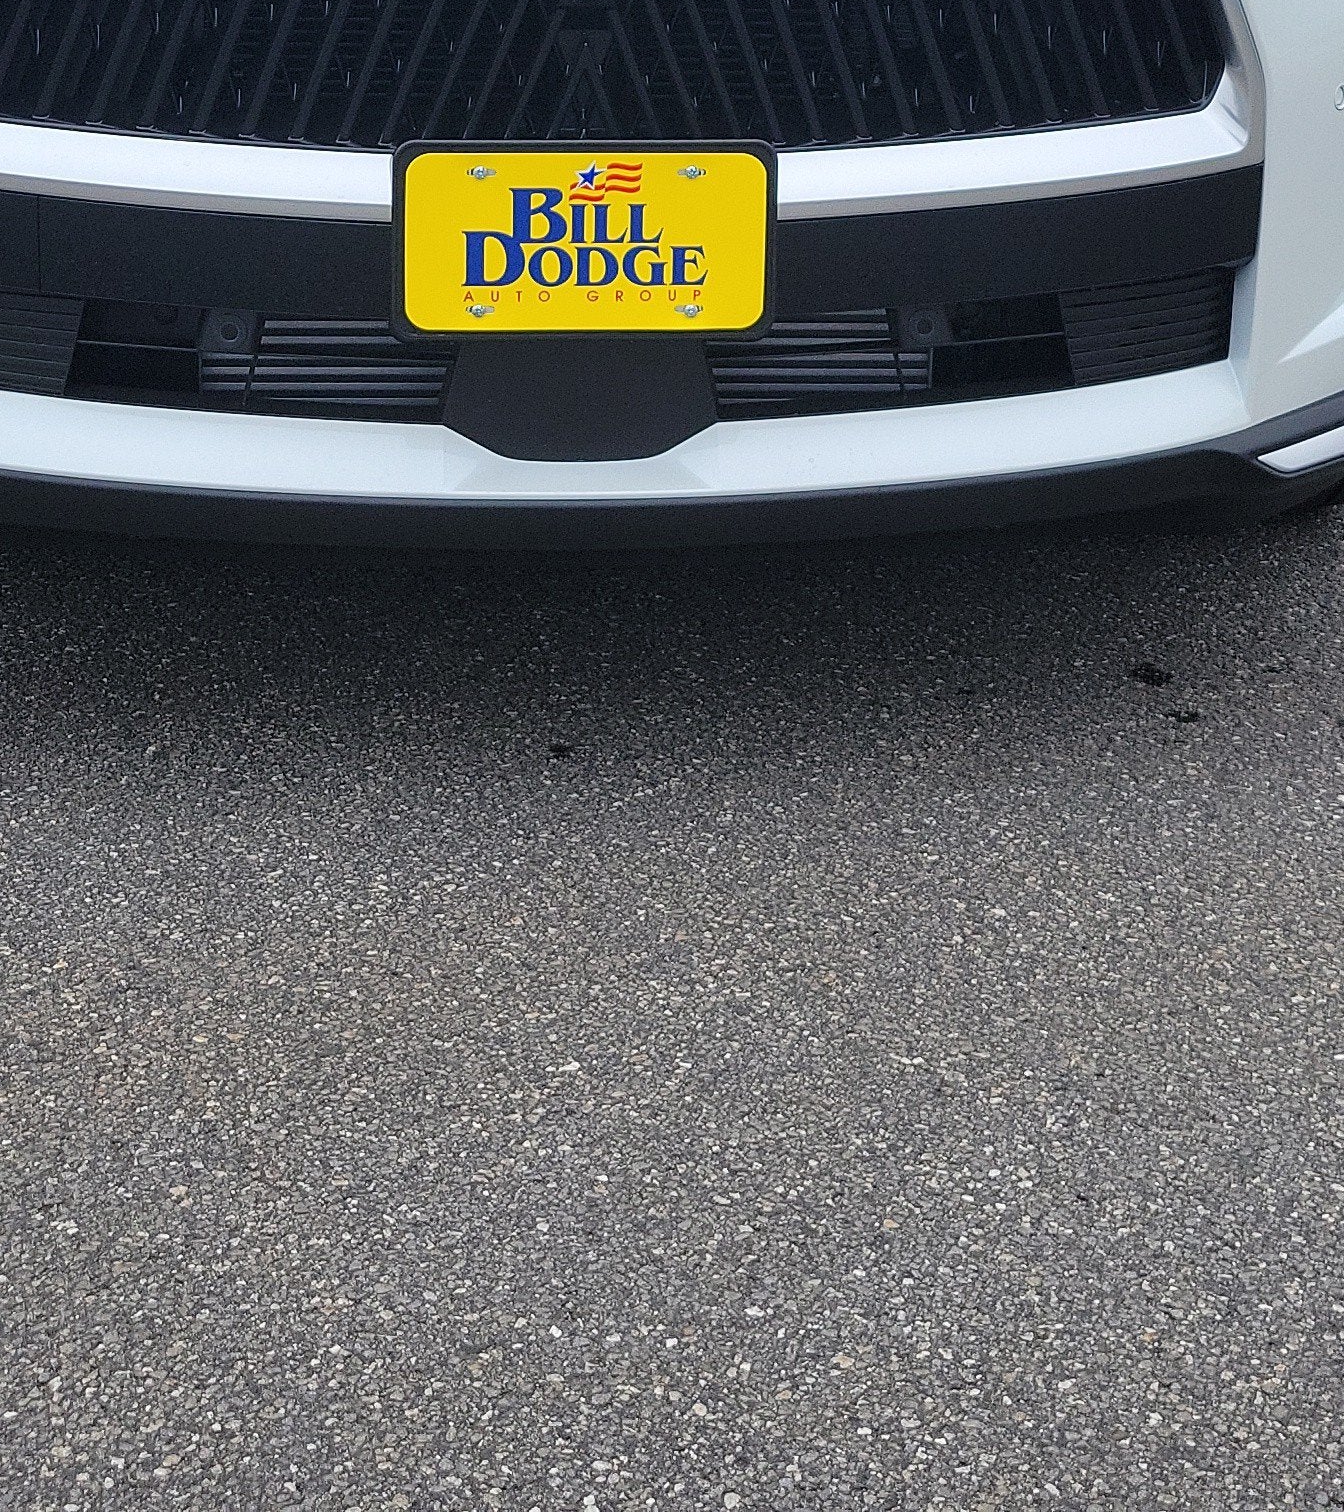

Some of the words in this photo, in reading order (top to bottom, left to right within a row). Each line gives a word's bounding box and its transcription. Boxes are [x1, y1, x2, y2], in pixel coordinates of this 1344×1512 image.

[508, 187, 665, 245] BILL
[460, 230, 709, 288] DODGE
[462, 290, 552, 303] AUTO
[586, 288, 702, 303] GROUP
